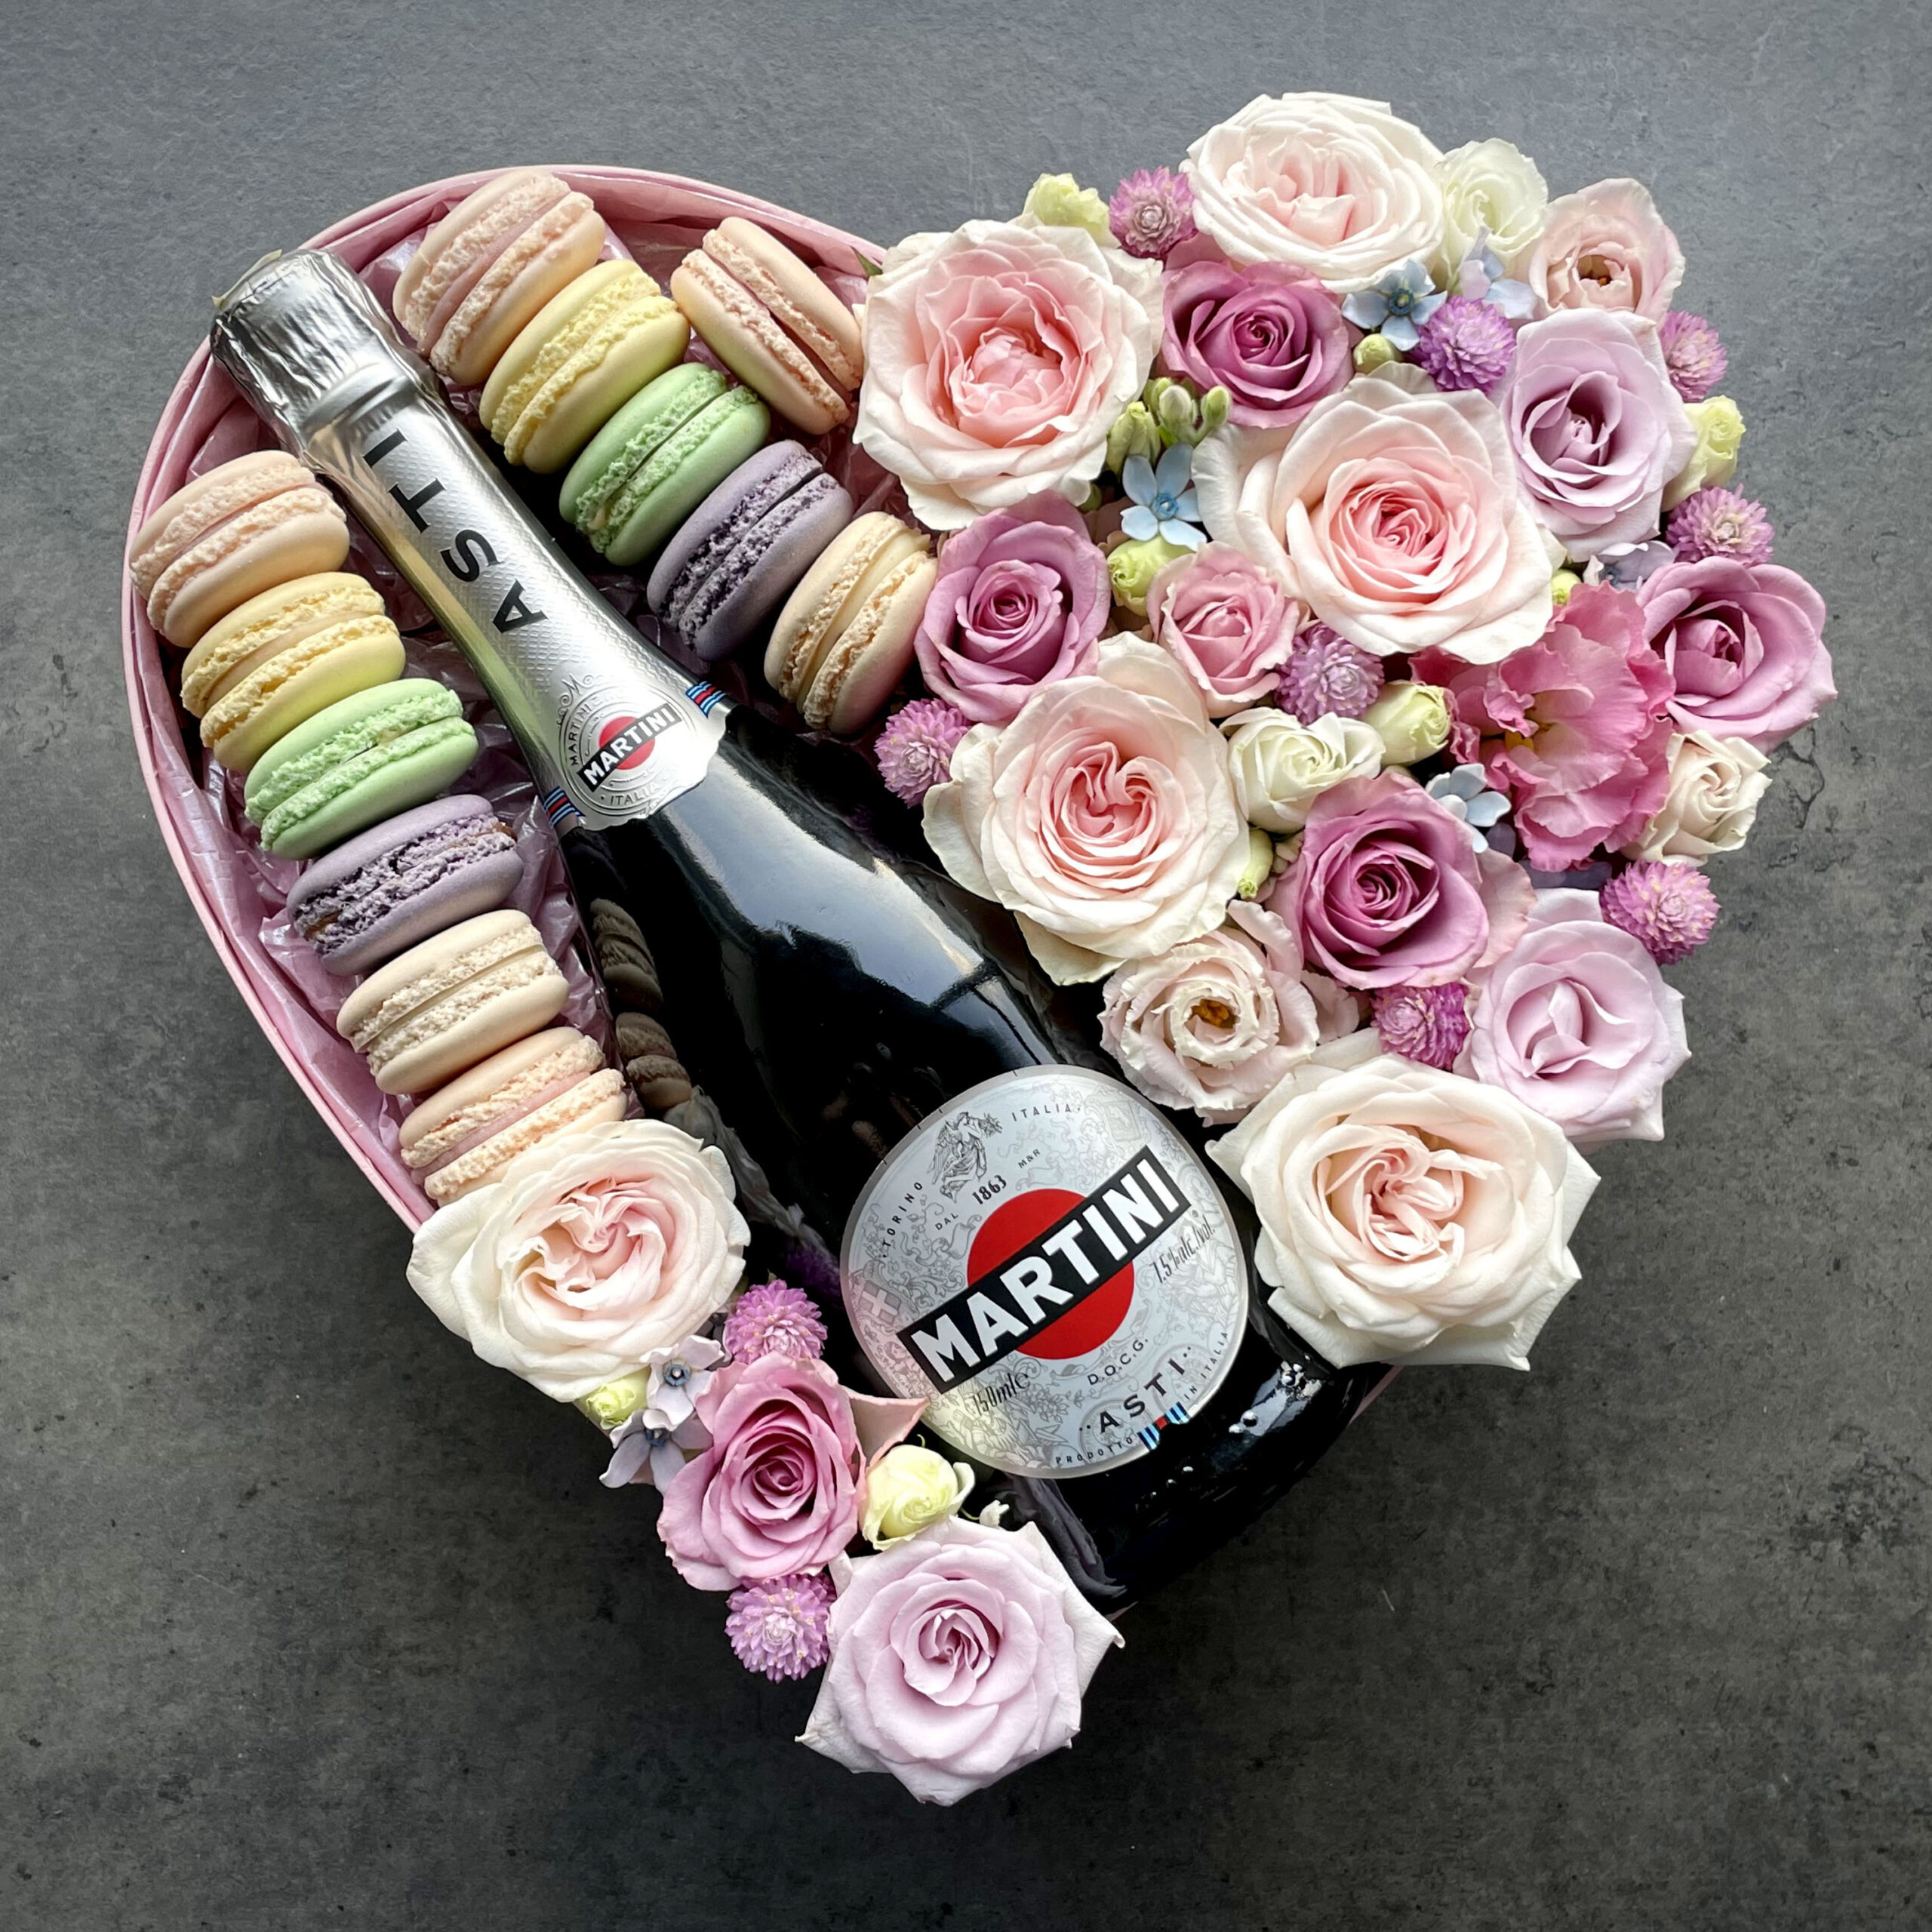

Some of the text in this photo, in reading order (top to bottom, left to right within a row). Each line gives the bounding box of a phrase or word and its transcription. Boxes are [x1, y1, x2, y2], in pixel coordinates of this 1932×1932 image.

[363, 429, 549, 633] ASTI
[583, 707, 675, 786] MARTINI
[882, 1103, 1071, 1247] TORINO ITALIA
[935, 1148, 1041, 1231] DAL 1863 M&R
[910, 1158, 1180, 1383] MARTINI
[1056, 1331, 1229, 1464] PRODOTTO IN ITALIA
[1087, 1338, 1149, 1386] D.O.C.G.
[1098, 1358, 1186, 1434] ASTI
